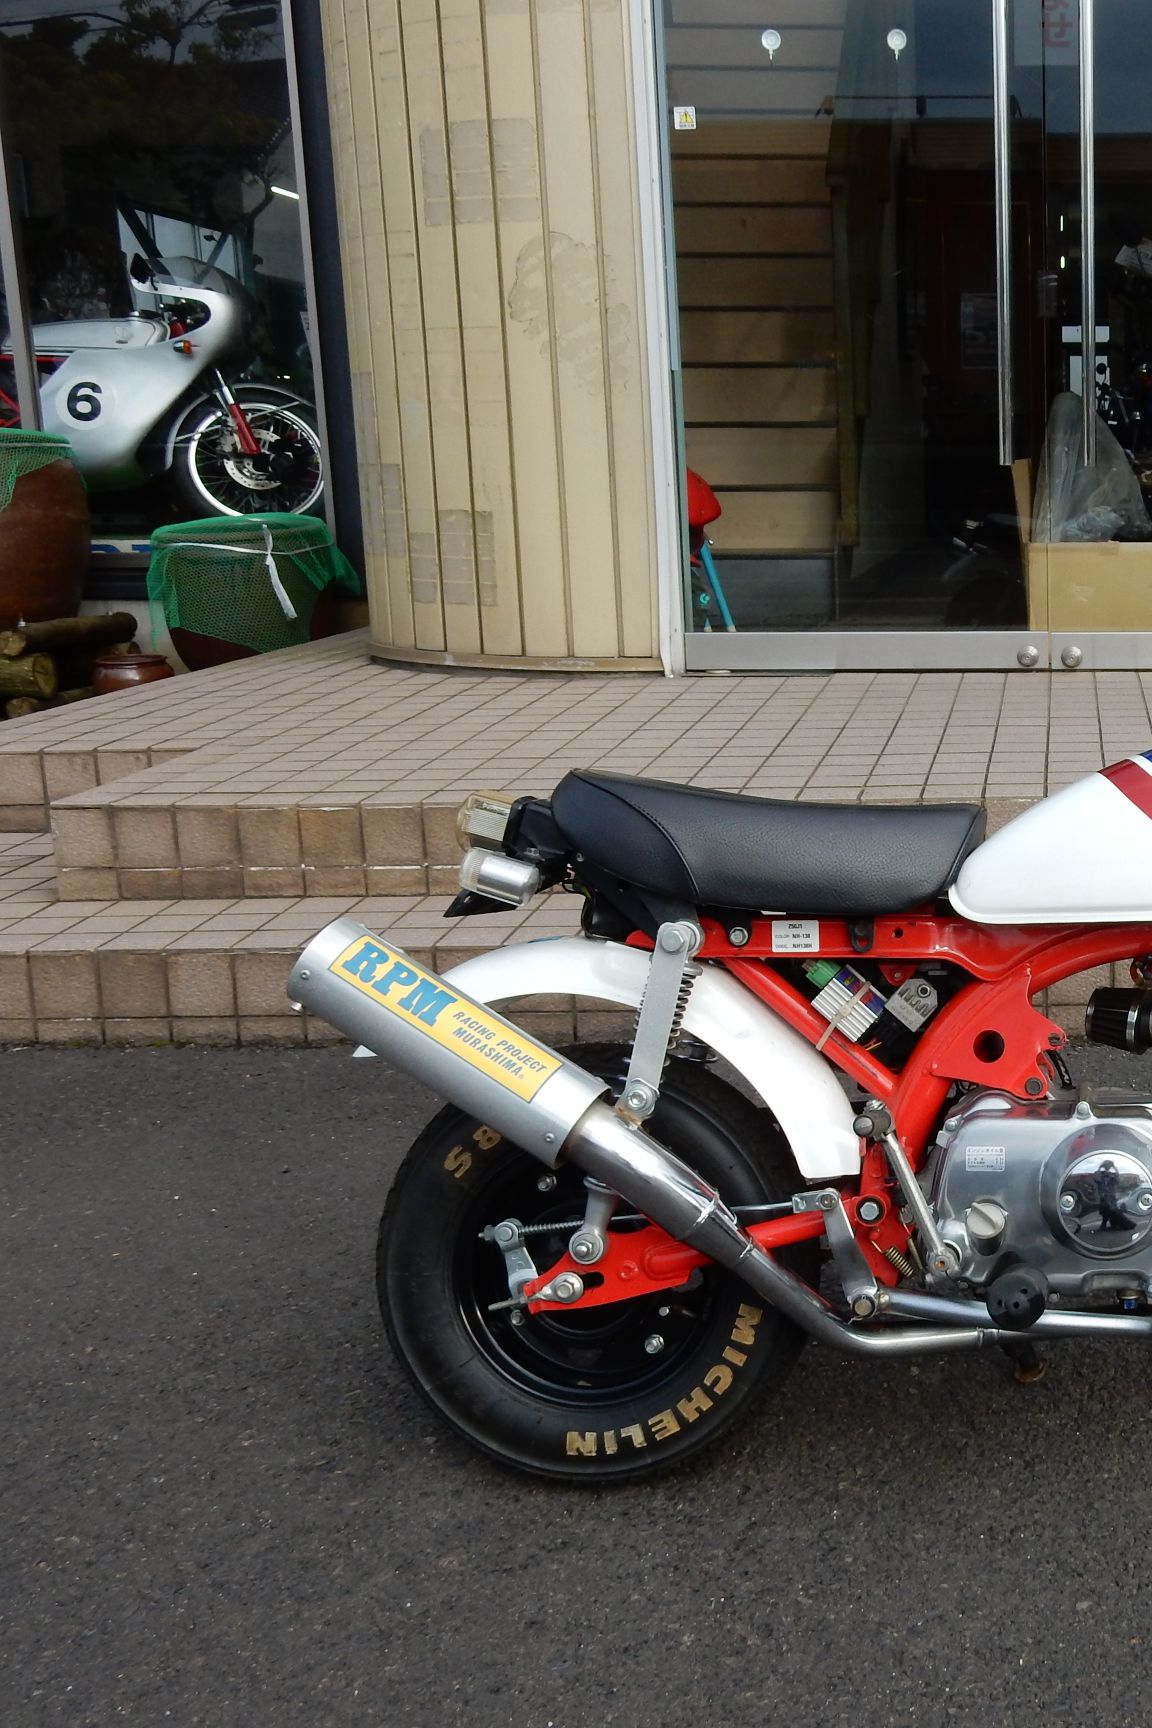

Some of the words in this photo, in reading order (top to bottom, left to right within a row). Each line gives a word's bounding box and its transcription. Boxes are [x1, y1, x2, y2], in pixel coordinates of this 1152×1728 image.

[67, 382, 103, 421] 6
[342, 941, 458, 1027] RPM
[453, 1011, 497, 1041] RACING
[496, 1039, 548, 1074] PROJECT
[566, 1303, 763, 1456] MICHELIN
